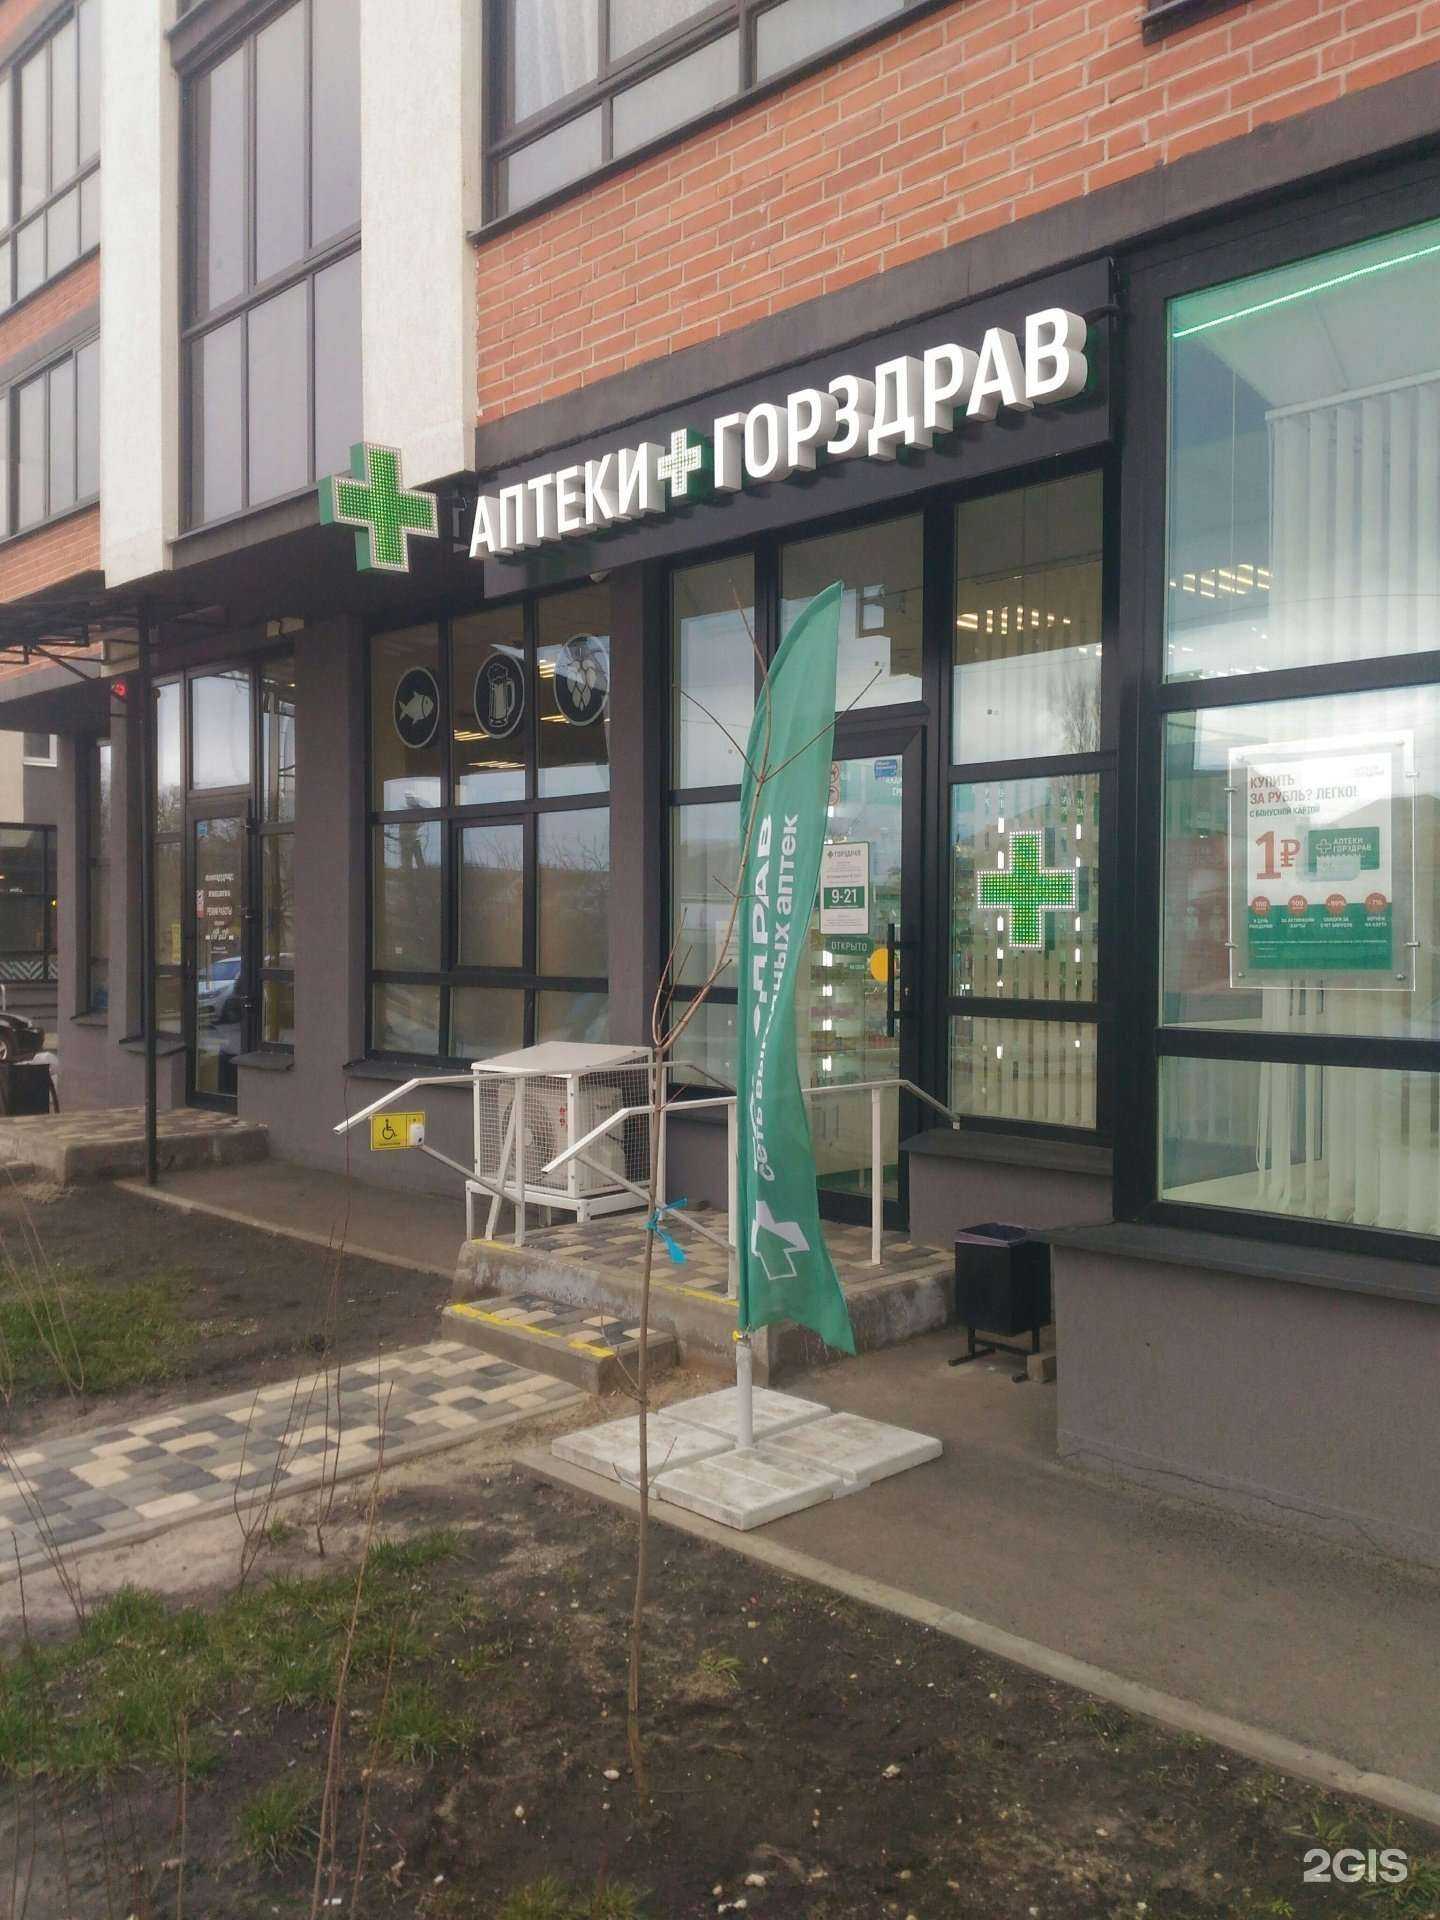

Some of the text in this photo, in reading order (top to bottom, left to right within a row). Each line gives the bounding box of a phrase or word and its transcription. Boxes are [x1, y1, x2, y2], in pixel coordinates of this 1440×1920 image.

[468, 306, 1087, 559] АПТЕКИ ГОРЗДРАВ
[1250, 774, 1295, 789] КУПИТЬ
[1250, 785, 1357, 805] ЗА РУБЛЬ? ЛЕГКО!
[776, 814, 799, 916] аптек
[831, 888, 857, 904] 9-21
[831, 941, 868, 952] ОТКРЫТО
